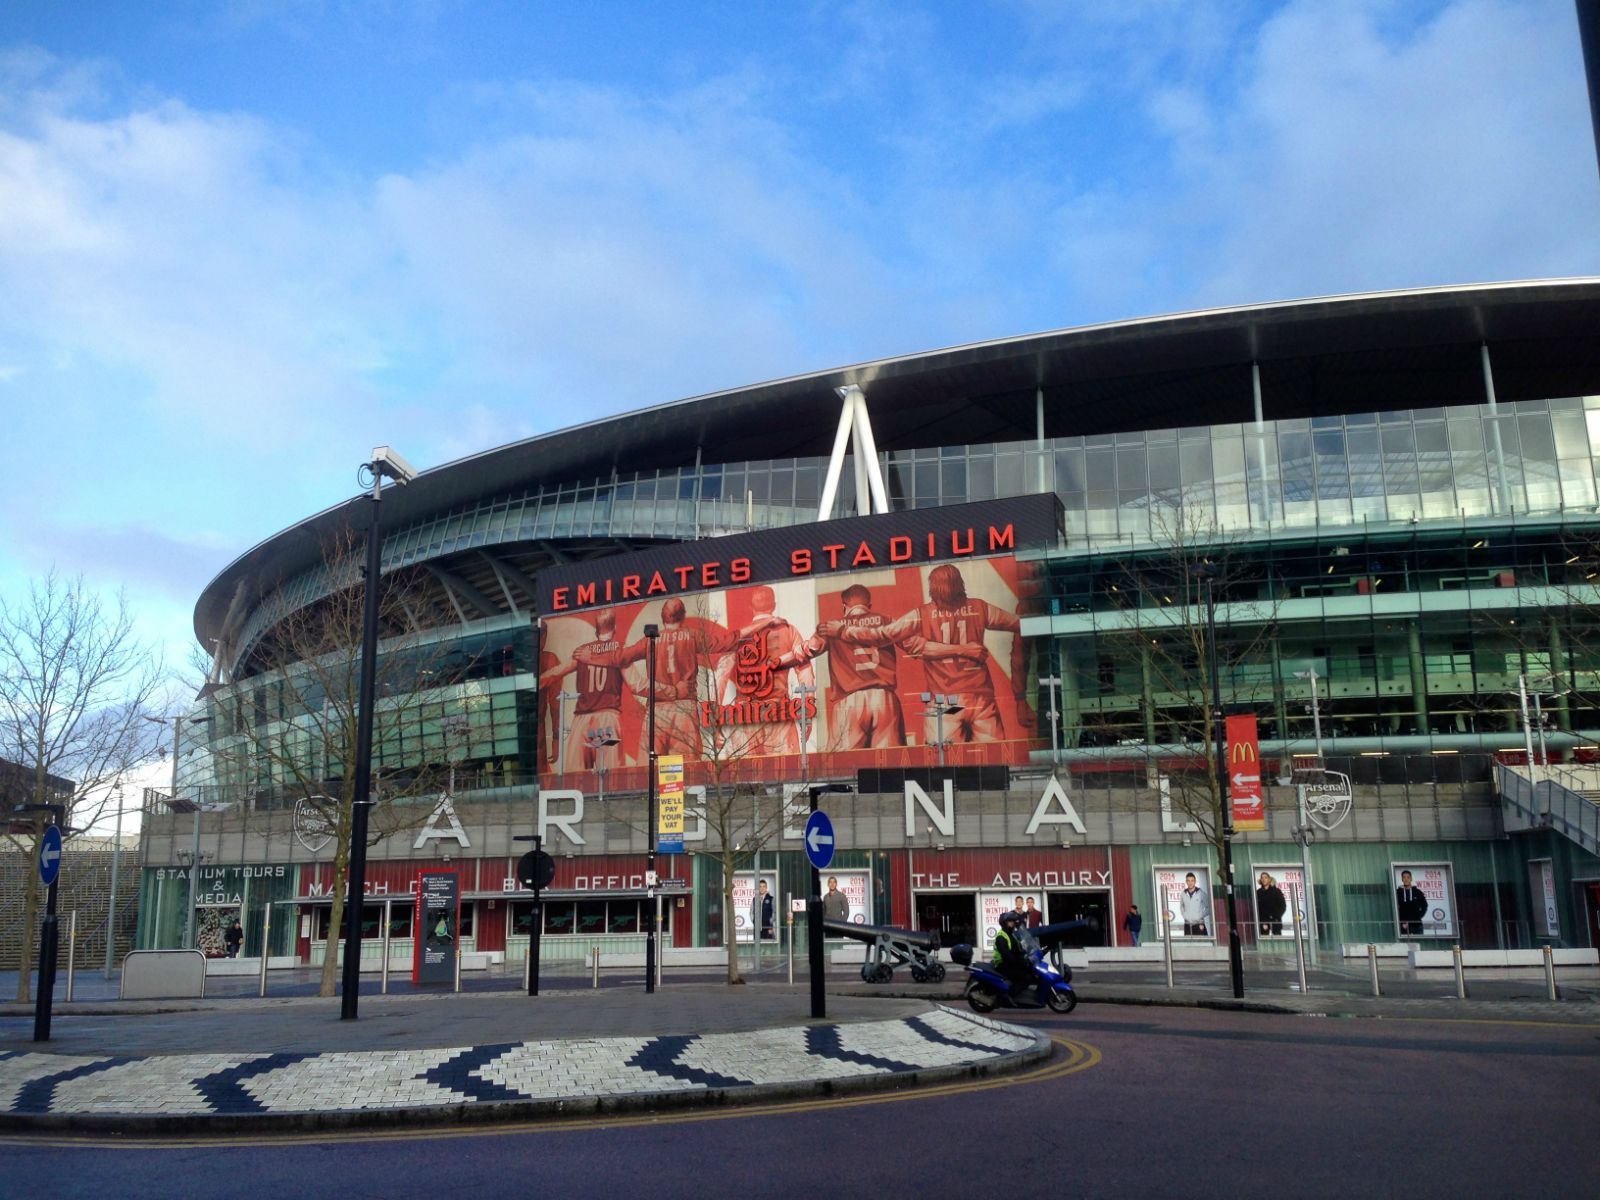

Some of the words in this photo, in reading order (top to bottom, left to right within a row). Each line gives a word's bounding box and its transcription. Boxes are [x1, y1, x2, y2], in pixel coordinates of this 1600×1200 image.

[553, 558, 751, 610] EMIRATES
[791, 524, 1014, 574] STADIUM
[655, 631, 690, 642] WILSON
[701, 696, 817, 727] Emirates
[233, 866, 285, 877] TOURS
[213, 880, 225, 891] &
[576, 874, 650, 890] OFFIC
[912, 873, 960, 887] THE
[991, 871, 1110, 887] ARMOURY
[196, 893, 241, 903] MEDIA
